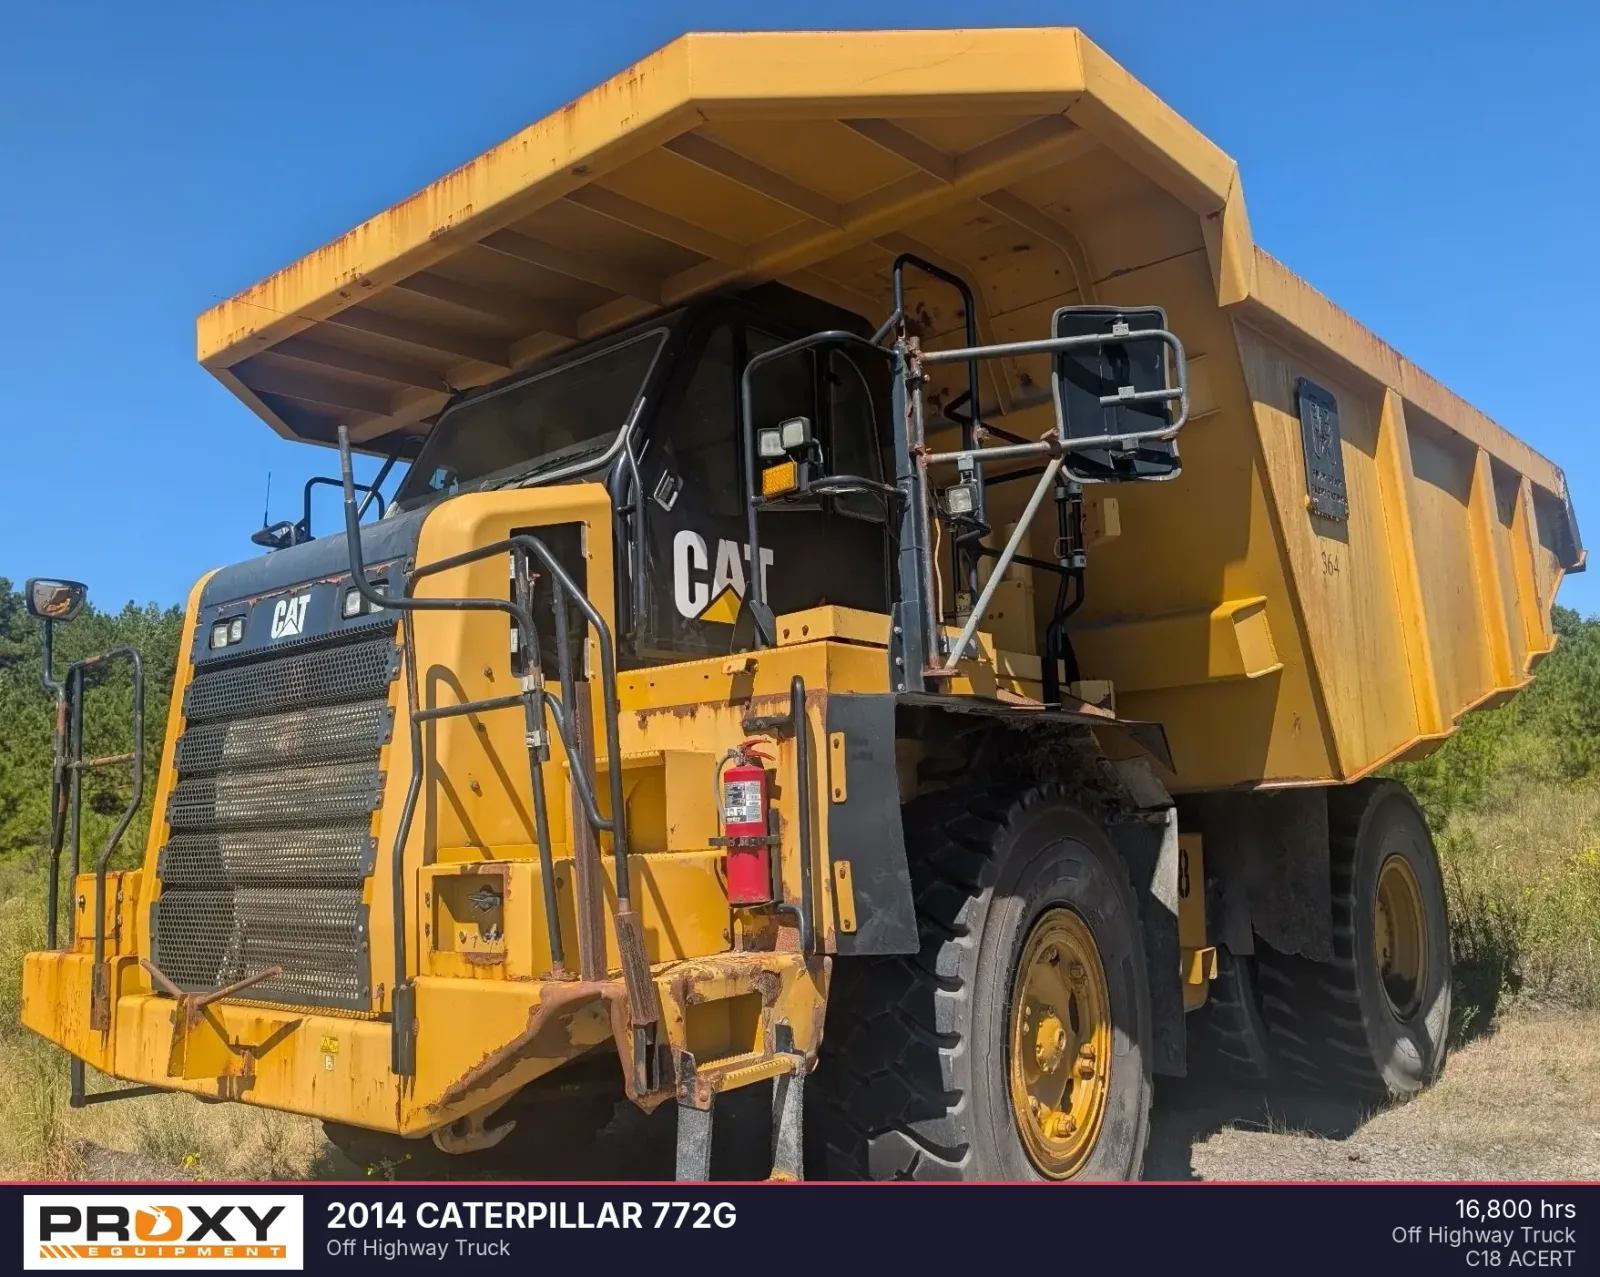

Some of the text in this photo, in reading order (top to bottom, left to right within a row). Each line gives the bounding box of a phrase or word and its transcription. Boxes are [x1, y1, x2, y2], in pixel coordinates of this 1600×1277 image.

[674, 530, 774, 619] CAT
[1321, 552, 1340, 576] 364
[271, 594, 311, 639] CAT
